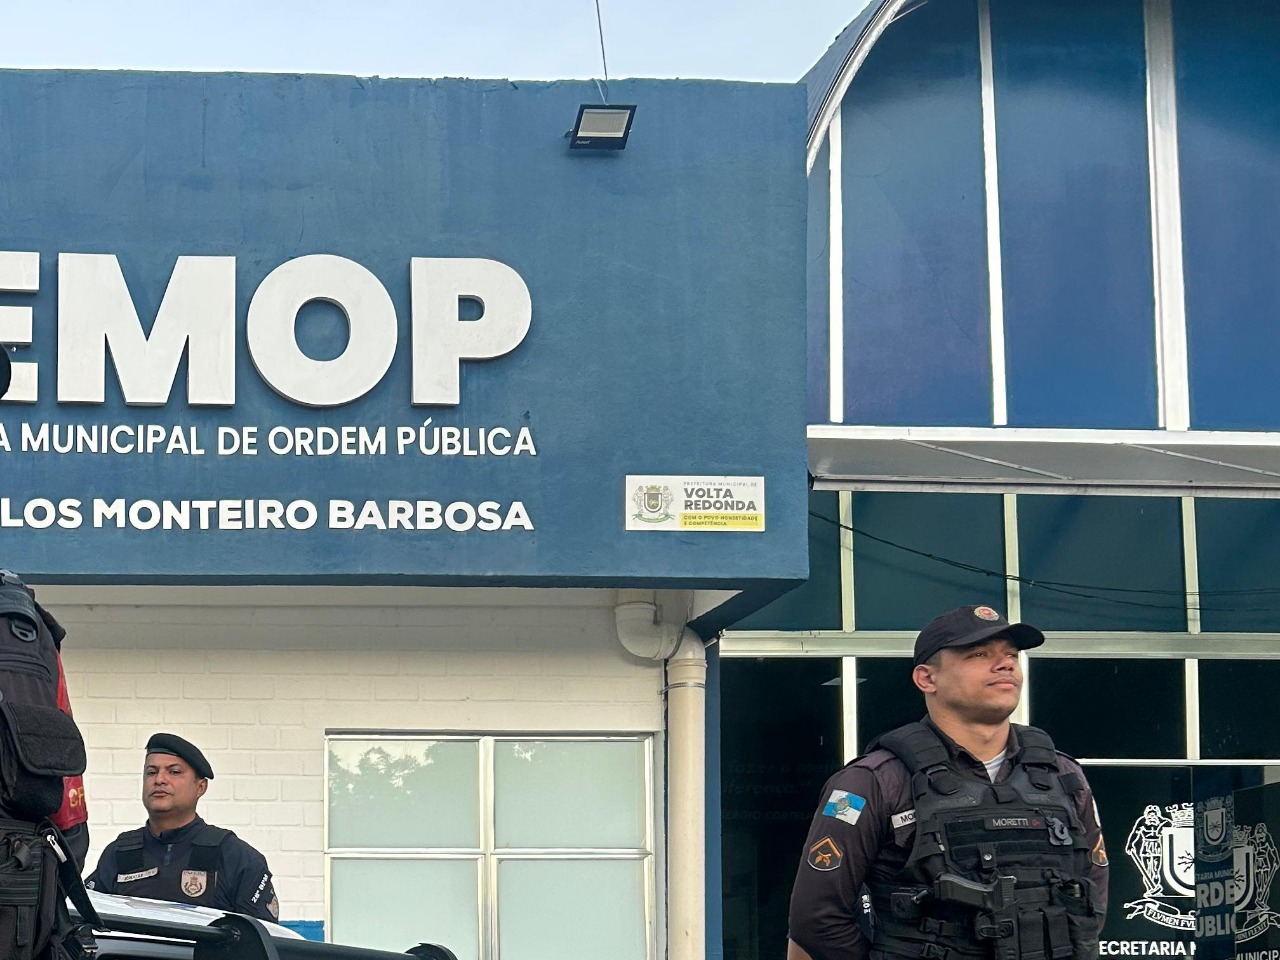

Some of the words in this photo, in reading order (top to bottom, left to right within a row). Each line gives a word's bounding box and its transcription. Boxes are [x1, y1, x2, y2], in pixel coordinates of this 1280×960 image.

[20, 424, 205, 455] MUNICIPAL
[218, 427, 258, 455] DE
[268, 426, 386, 456] ORDEM
[397, 417, 537, 456] PÚBLICA
[683, 488, 734, 499] VOLTA
[684, 499, 758, 511] REDONDA
[93, 498, 318, 530] MONTEIRO
[328, 500, 535, 532] BARBOSA
[992, 818, 1029, 827] MORETTI
[1098, 940, 1187, 956] ECRETARIA
